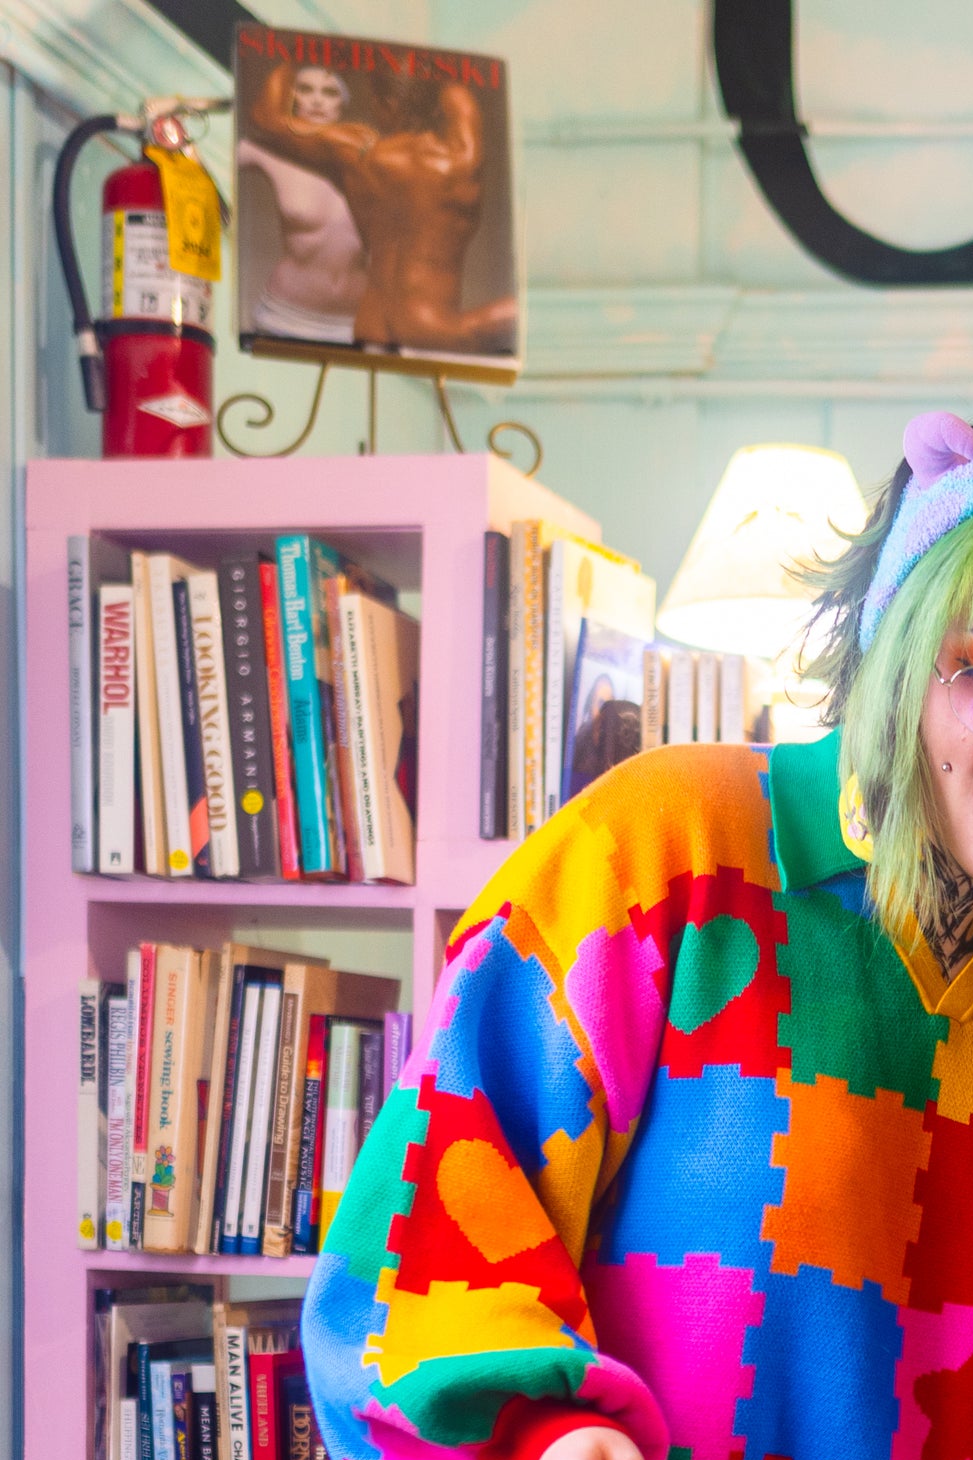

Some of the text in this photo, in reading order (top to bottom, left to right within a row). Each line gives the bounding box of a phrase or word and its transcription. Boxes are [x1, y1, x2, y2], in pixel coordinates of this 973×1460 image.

[239, 29, 499, 90] SKREBNESKI
[67, 559, 83, 636] GRACE
[279, 542, 310, 681] Thomas Hart Benton
[103, 600, 129, 715] WARHOL
[345, 609, 359, 668] ELIZABETH
[230, 567, 258, 790] GIORGIO ARMANI
[191, 614, 230, 833] LOOKING GOOD
[292, 697, 313, 744] Adams
[354, 715, 368, 769] PAINTINGS
[360, 770, 370, 792] AND
[362, 793, 375, 847] DRAWINGS
[109, 1006, 126, 1040] REGIS
[158, 971, 177, 1131] SINGER sewing book
[387, 1022, 402, 1079] afternoon
[108, 1041, 126, 1087] PHILBIN
[273, 1045, 292, 1145] Guide to Drawing
[108, 1117, 124, 1132] I'M
[108, 1132, 124, 1160] ONLY
[298, 1080, 313, 1189] NEW AGE MUSIC
[307, 1098, 317, 1155] INTERNATIONAL
[107, 1159, 123, 1180] ONE
[107, 1179, 123, 1204] MAN!
[226, 1334, 244, 1432] MAN ALIVE
[255, 1373, 269, 1447] VREELAND
[199, 1406, 211, 1443] MEAN
